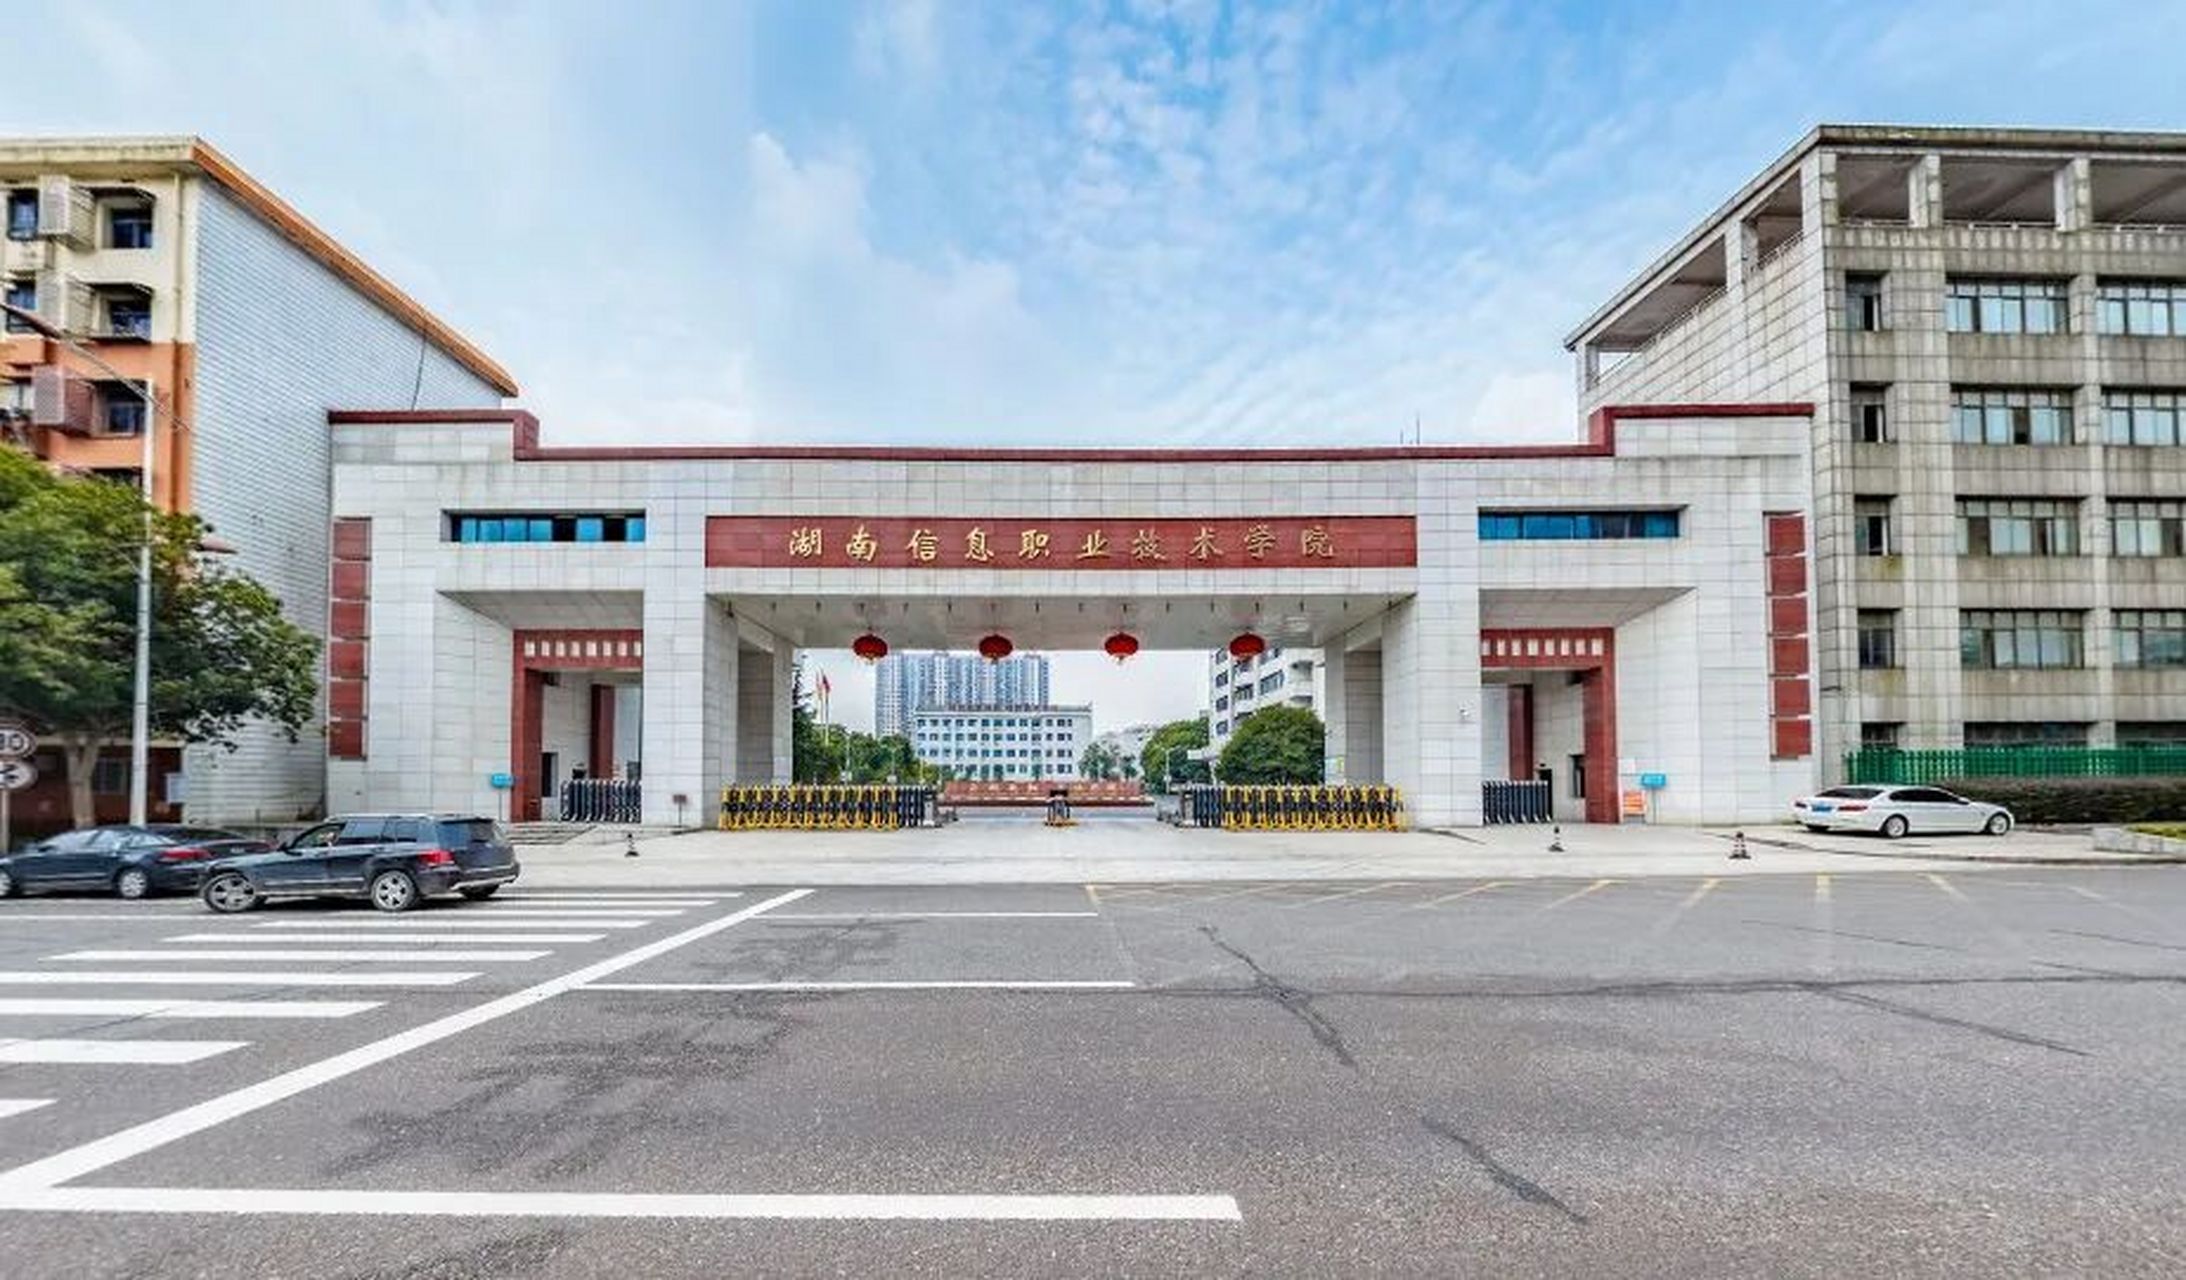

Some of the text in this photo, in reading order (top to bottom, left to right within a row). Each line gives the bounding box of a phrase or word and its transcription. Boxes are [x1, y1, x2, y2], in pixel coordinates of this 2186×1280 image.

[789, 525, 1335, 561] 湖南信息职业技术学院
